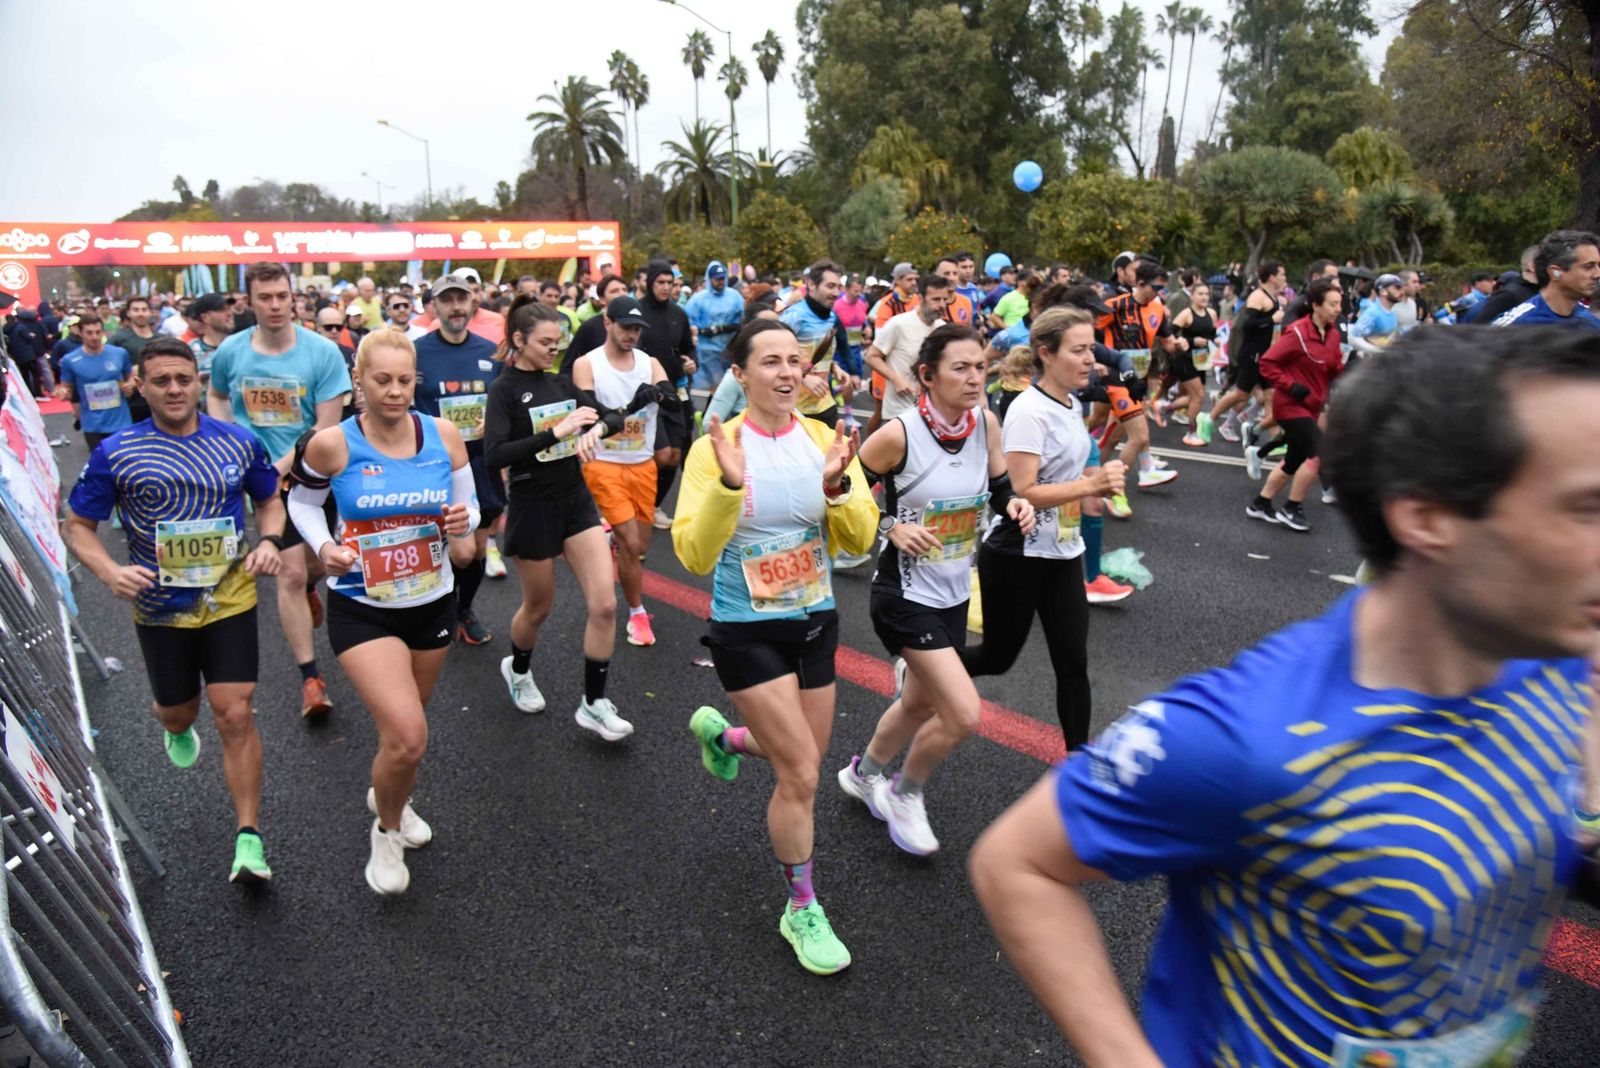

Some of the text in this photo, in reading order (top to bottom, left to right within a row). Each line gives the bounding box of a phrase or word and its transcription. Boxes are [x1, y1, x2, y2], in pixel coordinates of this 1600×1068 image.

[251, 390, 287, 406] 7538
[625, 421, 641, 434] 56
[356, 488, 448, 509] enerplus
[165, 535, 224, 558] 11057
[380, 545, 420, 573] 798
[759, 550, 812, 585] 5633
